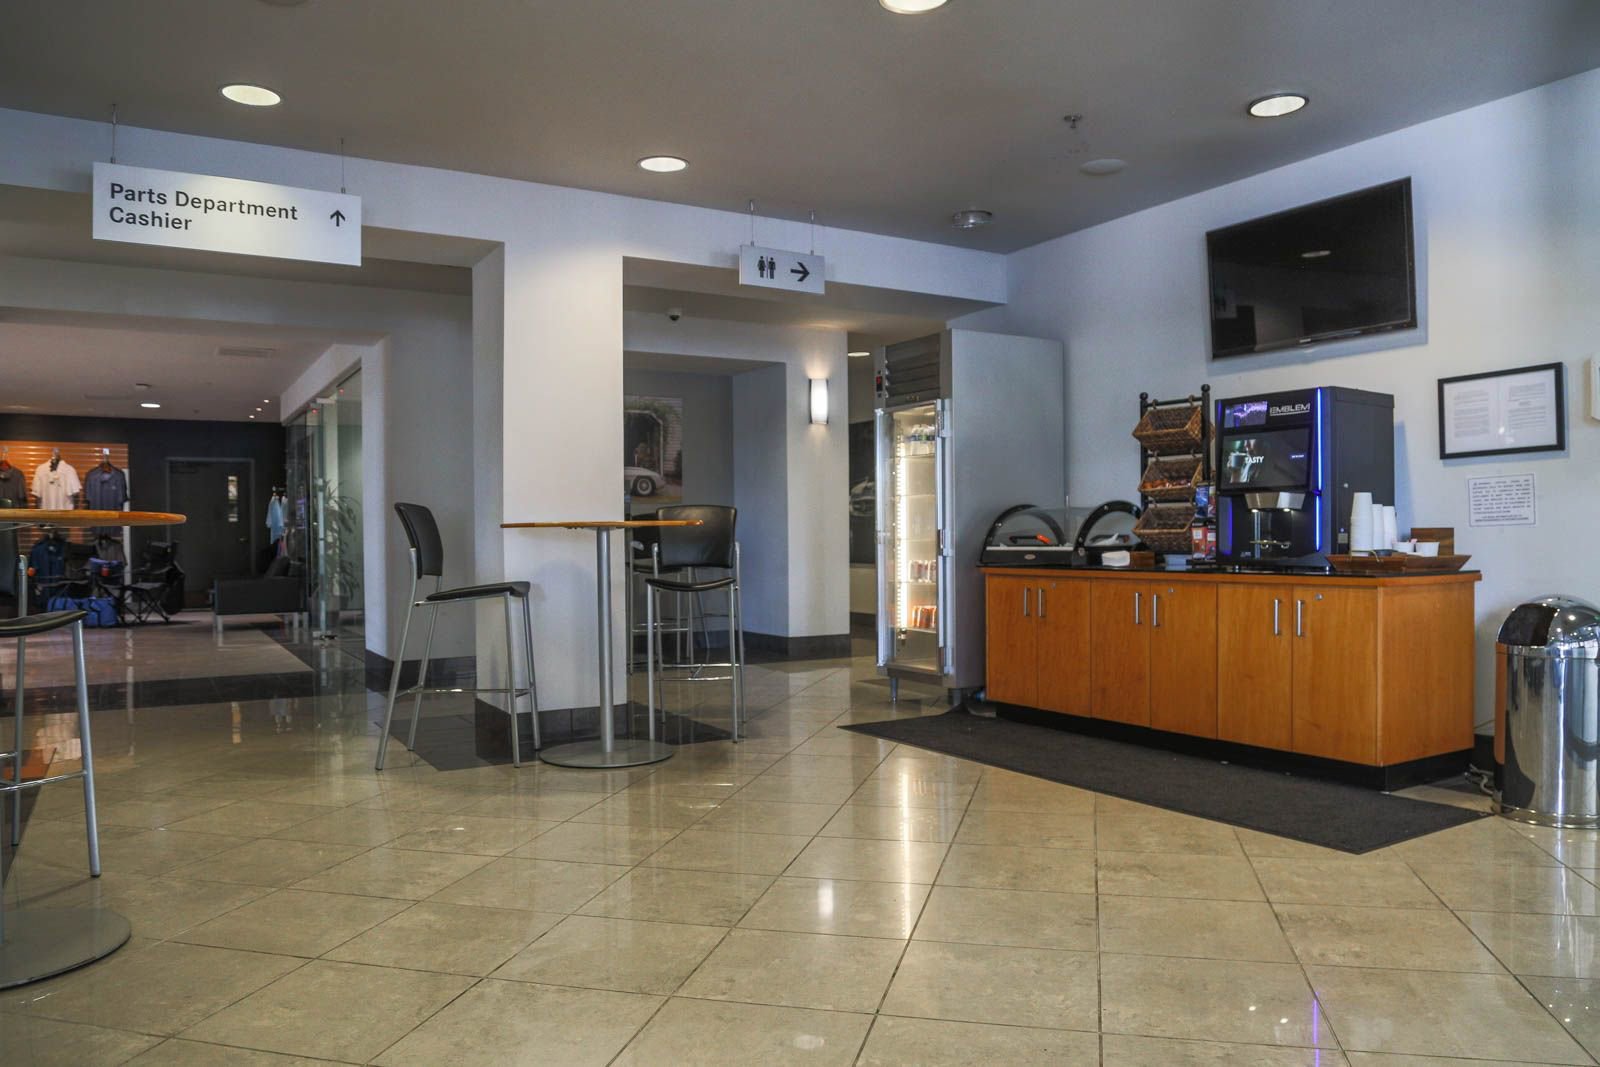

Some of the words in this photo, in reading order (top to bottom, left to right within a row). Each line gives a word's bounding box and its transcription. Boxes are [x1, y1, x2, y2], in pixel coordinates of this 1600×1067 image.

[110, 182, 167, 205] Parts
[175, 190, 298, 220] Department
[109, 206, 192, 230] Cashier
[1269, 403, 1311, 416] EMBLEM
[1244, 455, 1265, 465] TASTY
